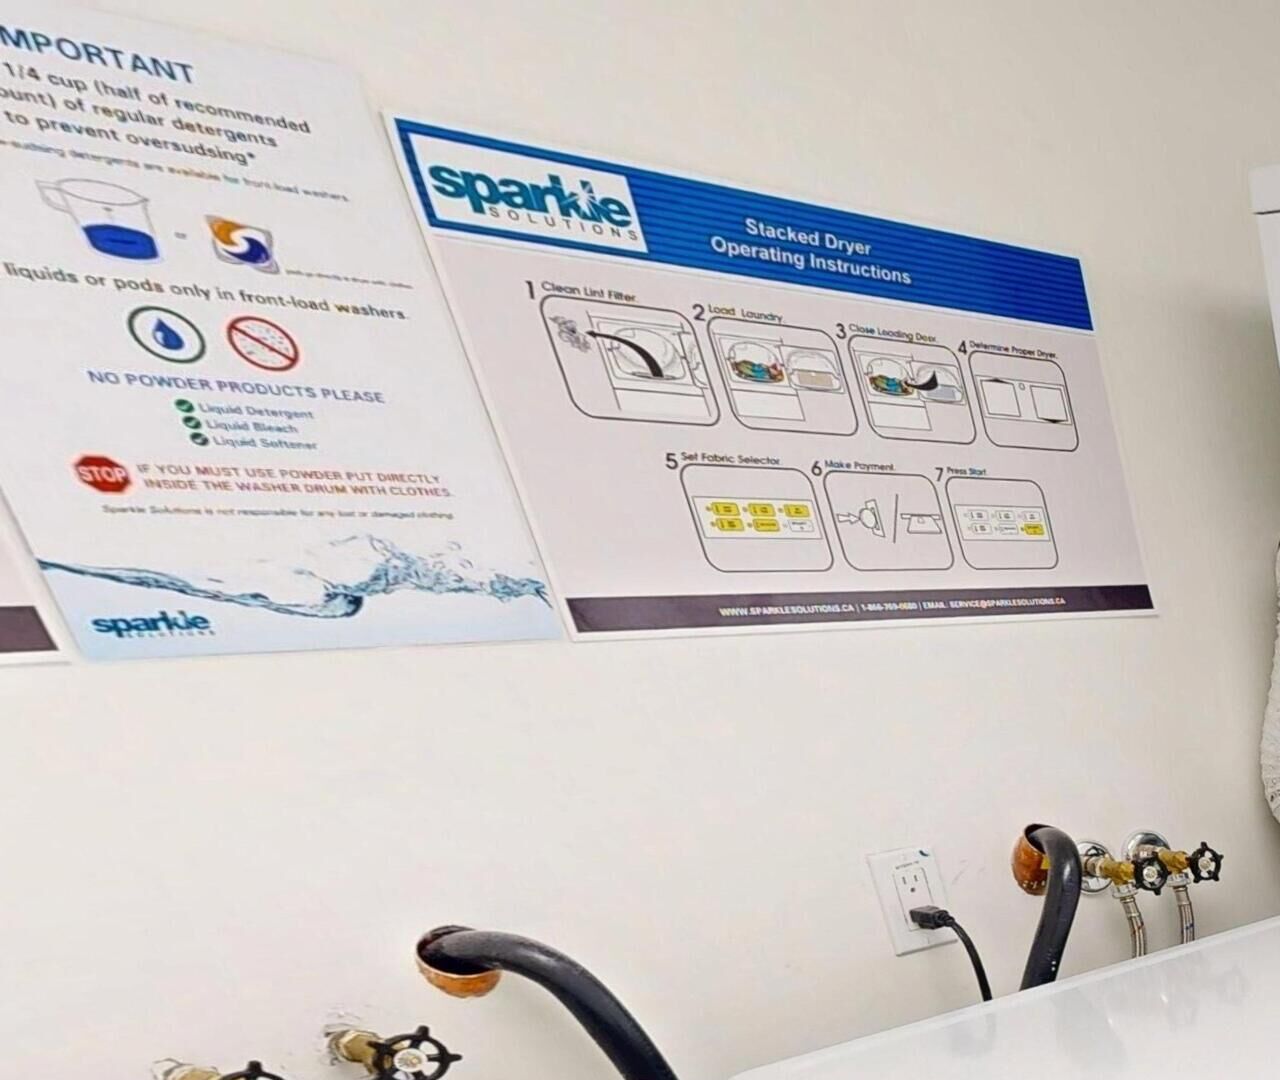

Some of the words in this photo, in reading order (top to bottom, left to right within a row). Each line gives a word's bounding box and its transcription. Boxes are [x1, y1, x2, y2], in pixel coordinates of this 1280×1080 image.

[2, 61, 41, 81] 1/4
[47, 73, 88, 93] cup
[94, 79, 142, 102] (half
[148, 92, 168, 107] of
[174, 97, 312, 134] recommended
[3, 110, 29, 125] to
[35, 117, 120, 142] prevent
[63, 97, 85, 112] of
[92, 105, 165, 128] regular
[172, 117, 278, 147] detergents
[427, 165, 633, 228] sparkle
[488, 206, 639, 241] SOLUTIONS
[744, 217, 821, 248] Stacked
[824, 232, 872, 258] Dryer
[710, 235, 805, 270] Operating
[809, 250, 912, 285] Instructions
[3, 261, 78, 285] liquids
[84, 273, 107, 287] or
[113, 275, 164, 296] pods
[170, 283, 211, 301] only
[216, 287, 236, 301] in
[239, 289, 330, 313] front-load
[525, 281, 535, 299] 1
[541, 281, 581, 295] Clean
[583, 286, 604, 298] Lint
[692, 304, 706, 321] 2
[708, 304, 736, 316] Load
[836, 323, 847, 339] 3
[848, 323, 875, 334] Close
[877, 328, 914, 342] Loading
[957, 341, 967, 355] 4
[969, 341, 1009, 352] Determine
[1011, 345, 1035, 357] Proper
[87, 370, 121, 385] NO
[127, 374, 215, 391] POWDER
[217, 380, 317, 399] PRODUCTS
[321, 387, 385, 404] PLEASE
[198, 402, 242, 418] Liquid
[246, 406, 314, 421] Detergent
[206, 418, 248, 433] Liquid
[253, 421, 298, 434] Bleach
[213, 435, 256, 450] Liquid
[261, 438, 318, 451] Softener
[665, 453, 678, 469] 5
[681, 451, 698, 462] Set
[701, 453, 734, 464] Fabric
[811, 461, 822, 477] 6
[824, 460, 852, 470] Make
[78, 465, 128, 484] STOP
[137, 464, 150, 473] IF
[154, 464, 190, 475] YOU
[195, 466, 241, 477] MUST
[245, 468, 276, 478] USE
[279, 469, 343, 481] POWDER
[346, 471, 373, 481] PUT
[377, 472, 441, 484] DIRECTLY
[935, 467, 944, 482] 7
[946, 466, 967, 476] Press
[145, 479, 198, 490] INSIDE
[201, 480, 232, 491] THE
[235, 481, 301, 493] WASHER
[303, 484, 347, 495] DRUM
[350, 486, 387, 495] WITH
[719, 603, 854, 617] WWW.SPARKLESOLUTIONS.CA
[91, 610, 210, 638] sparkle
